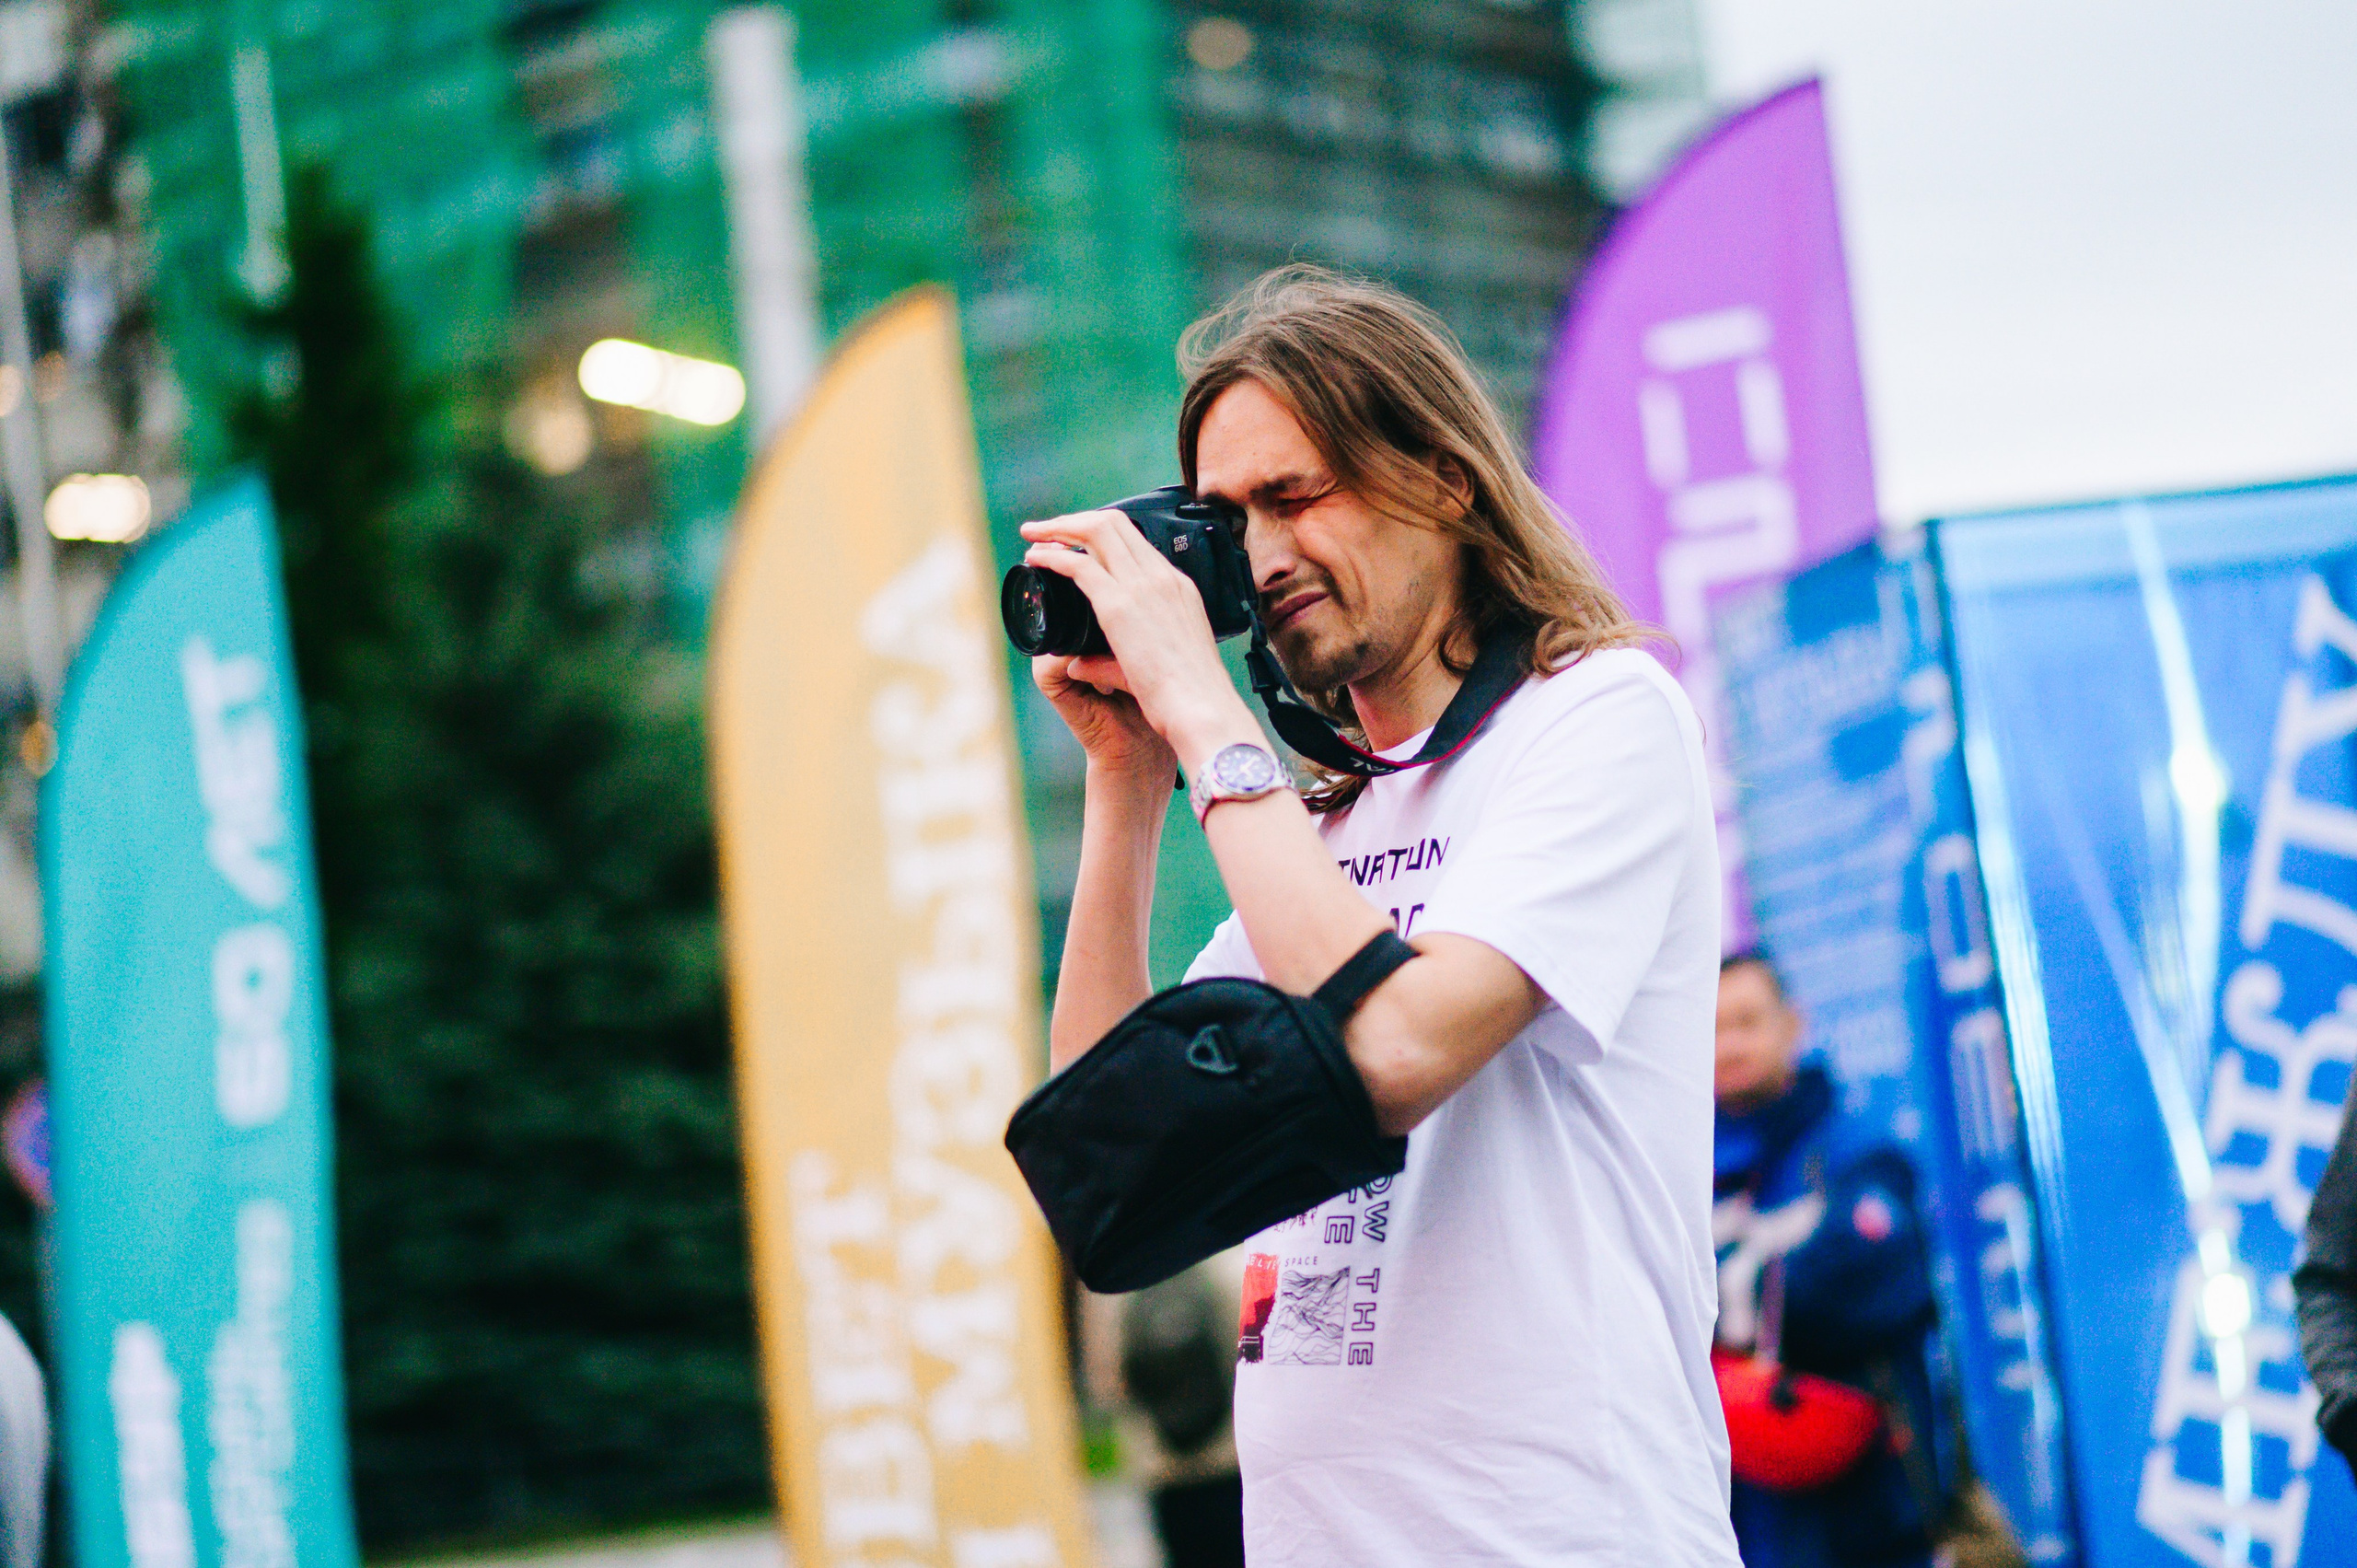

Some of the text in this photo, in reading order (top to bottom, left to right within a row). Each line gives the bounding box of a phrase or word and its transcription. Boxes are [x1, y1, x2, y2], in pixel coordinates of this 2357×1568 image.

[1174, 534, 1188, 545] EOS
[1175, 542, 1189, 552] 60D
[1284, 1255, 1318, 1268] SPACE
[1347, 1267, 1381, 1366] THE
[787, 1149, 936, 1568] ВЕТ
